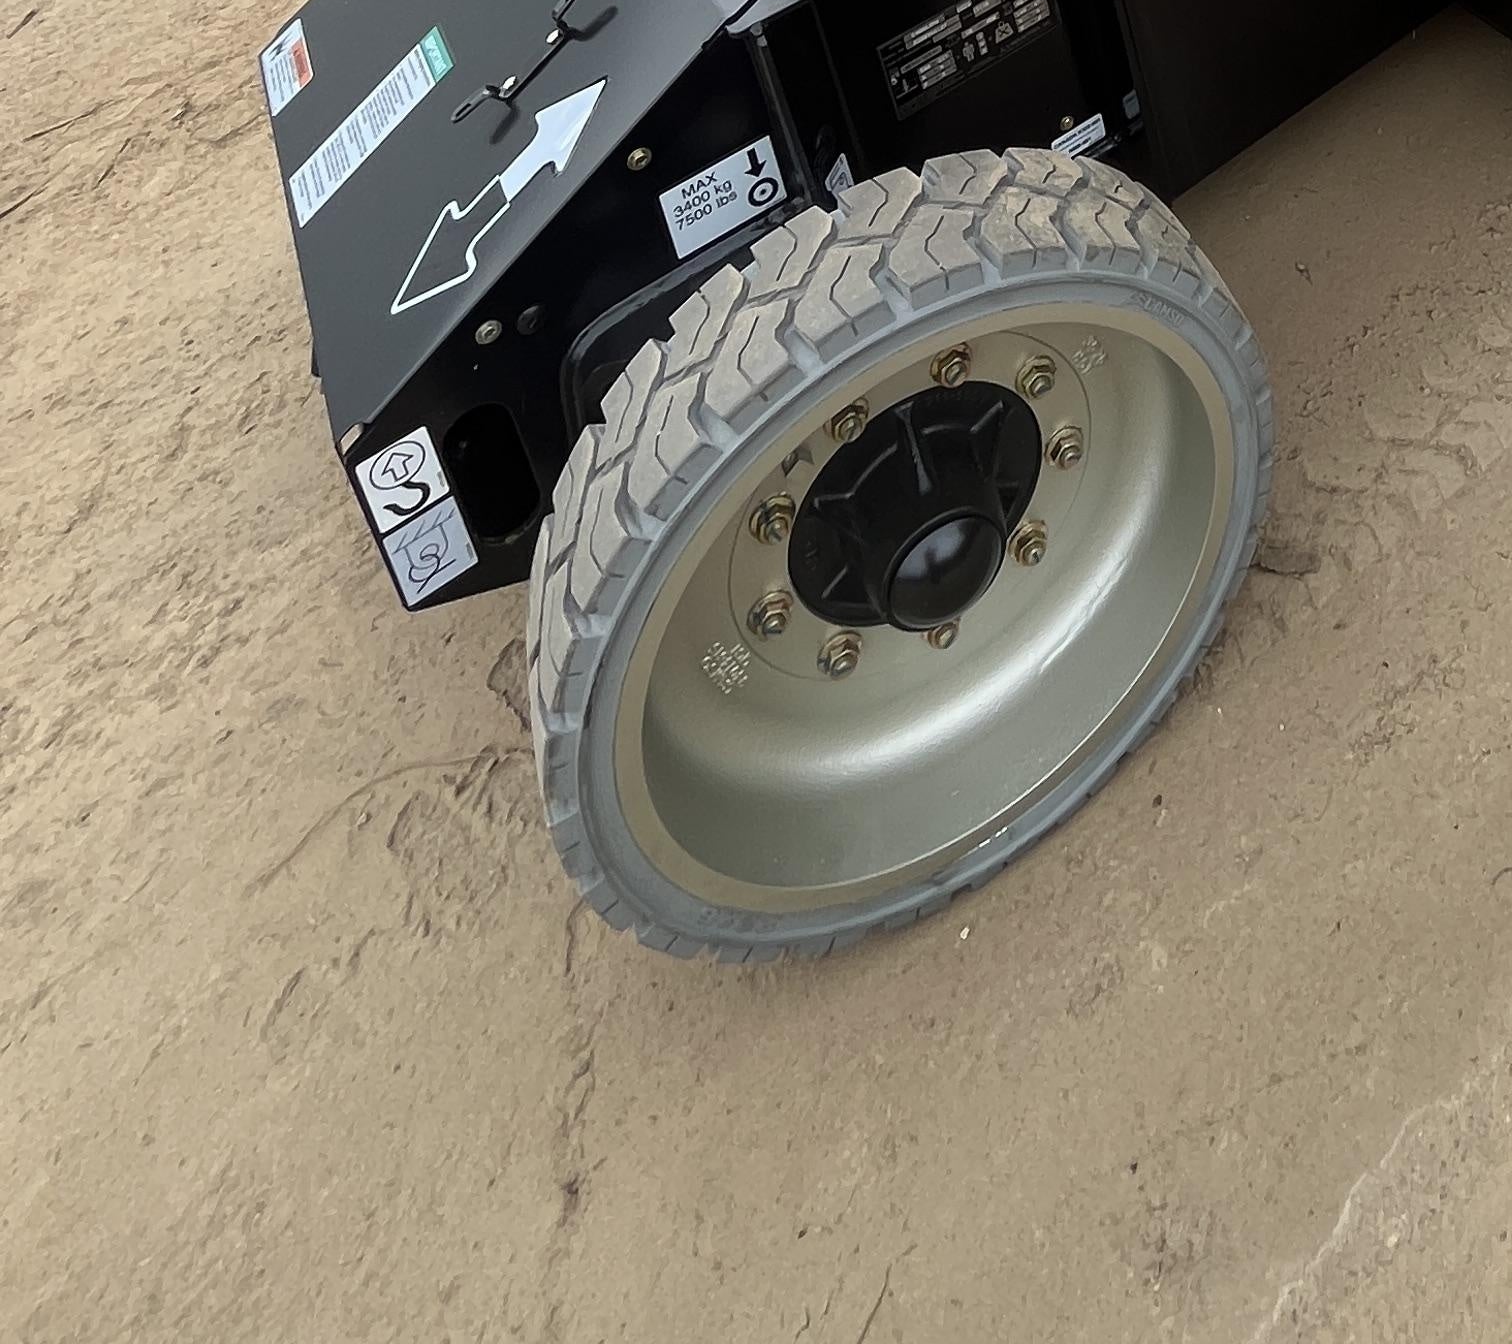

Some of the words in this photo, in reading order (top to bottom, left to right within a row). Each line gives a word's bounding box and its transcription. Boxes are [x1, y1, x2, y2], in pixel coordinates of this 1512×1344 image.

[673, 190, 711, 218] 3400
[713, 180, 733, 195] kg
[681, 171, 718, 199] MAX
[675, 203, 713, 231] 7500
[715, 191, 738, 209] lbs
